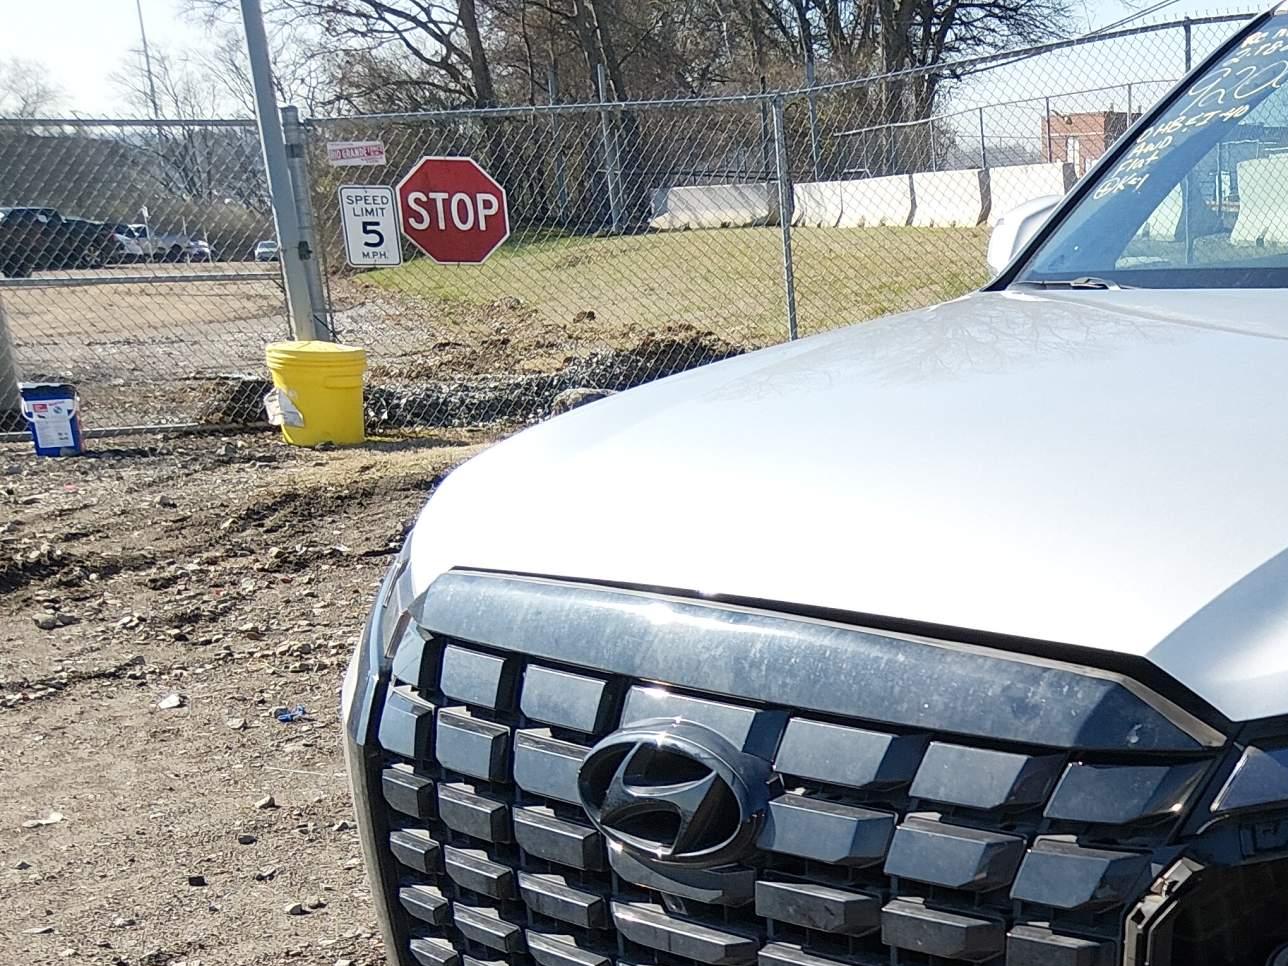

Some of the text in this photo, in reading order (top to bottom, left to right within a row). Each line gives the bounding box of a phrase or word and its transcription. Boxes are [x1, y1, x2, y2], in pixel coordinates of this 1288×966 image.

[346, 195, 390, 206] SPEED
[353, 207, 386, 217] LIMIT
[407, 192, 498, 231] STOP
[362, 221, 385, 248] 5
